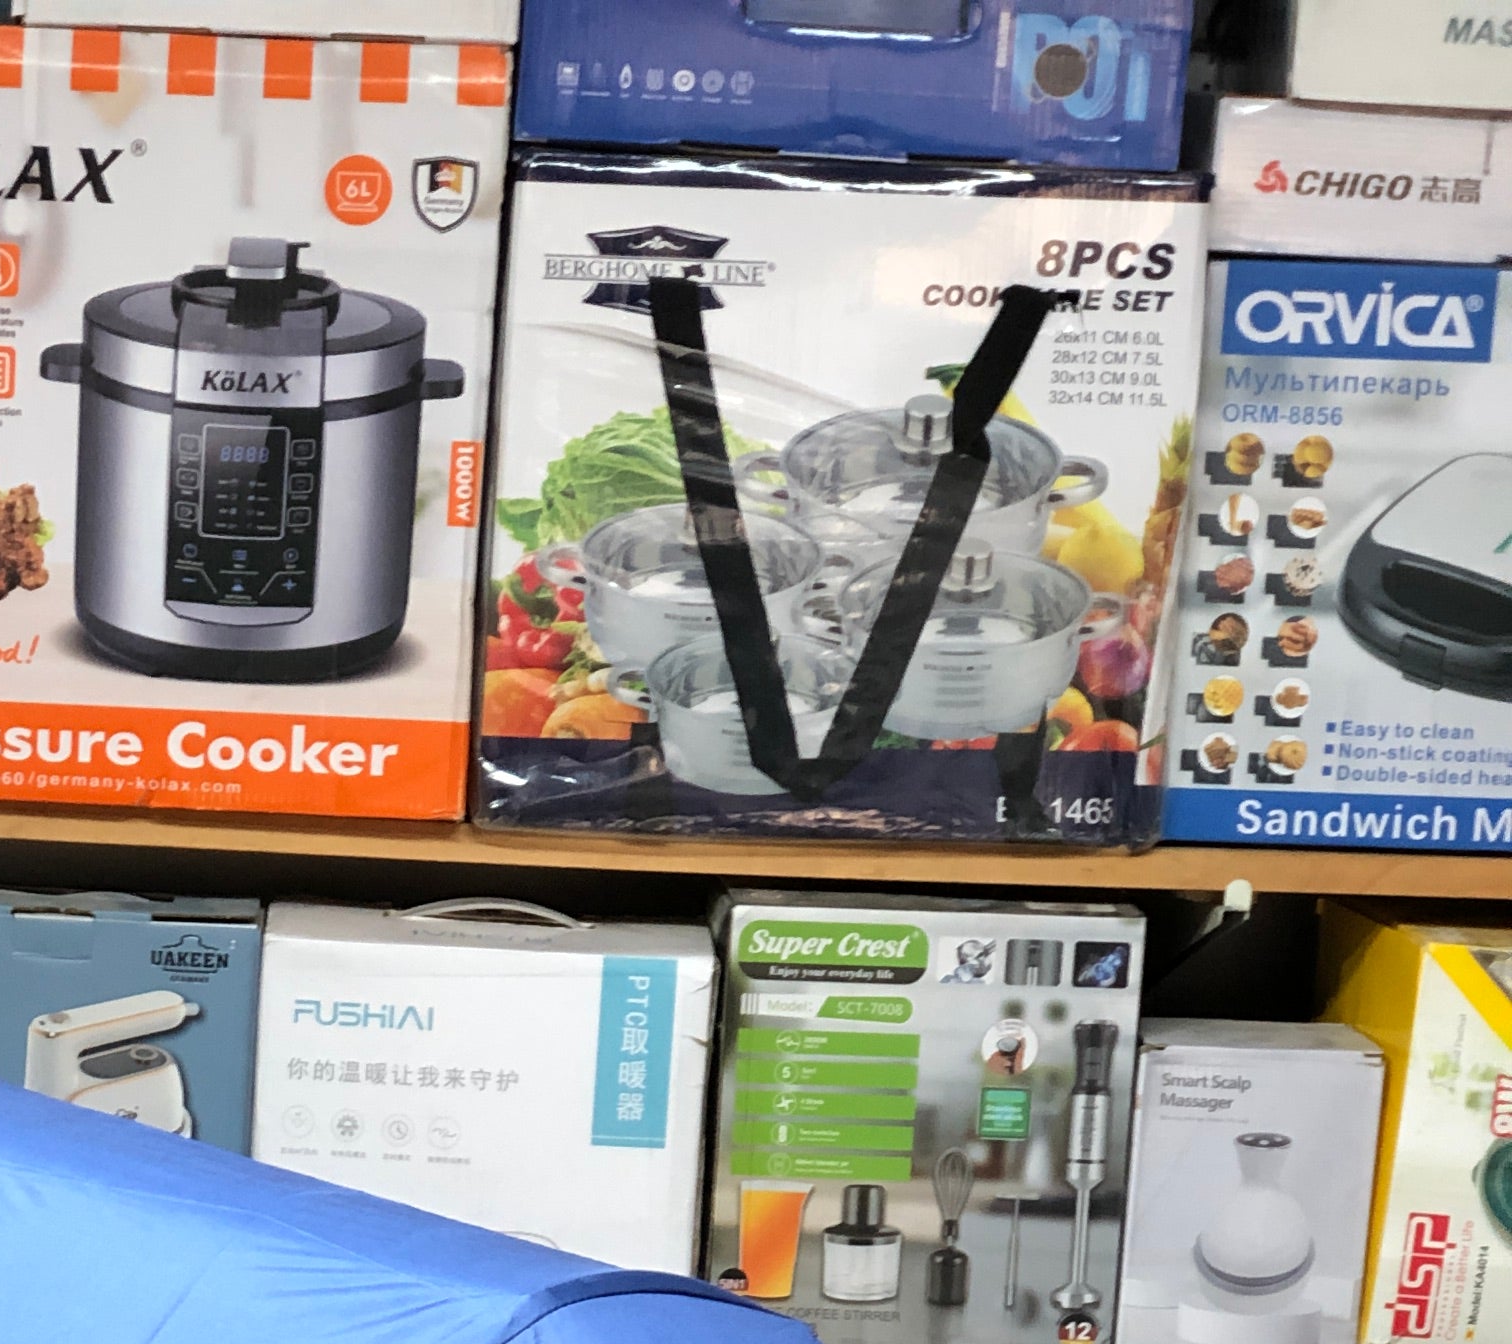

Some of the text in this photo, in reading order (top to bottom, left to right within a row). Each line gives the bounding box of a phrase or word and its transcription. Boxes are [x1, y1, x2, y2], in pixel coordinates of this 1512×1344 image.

[345, 179, 373, 199] 6L
[1293, 169, 1414, 201] CHIGO
[544, 257, 765, 284] BERGHOME LINE
[1036, 239, 1177, 281] 8PCS
[1112, 290, 1174, 313] SET
[1102, 332, 1129, 345] CM
[1132, 334, 1164, 346] 6.0L
[1051, 351, 1164, 366] 28x12 CM 7.5L
[1049, 370, 1161, 387] 30x13 CM 9.0L
[1224, 366, 1451, 401] Мультипекарь
[1047, 391, 1168, 407] 32x14 CM 11.5L
[1222, 403, 1344, 427] ORM-8856
[454, 445, 475, 522] 1000W
[1340, 720, 1475, 741] Easy to clean
[165, 721, 400, 778] Cooker
[1337, 742, 1436, 761] Non-stick
[1335, 764, 1473, 786] Double-sided
[1236, 799, 1458, 842] Sandwich
[748, 928, 912, 961] Super Crest
[768, 964, 895, 981] Enjoy your everyday life
[286, 1056, 521, 1093] 你的温暖让我来守护
[1161, 1071, 1252, 1094] Smart Scalp
[1159, 1092, 1235, 1113] Massager
[1460, 1220, 1475, 1242] Life
[1453, 1245, 1472, 1283] Better
[1064, 1320, 1093, 1341] 12
[1445, 1297, 1465, 1341] Create
